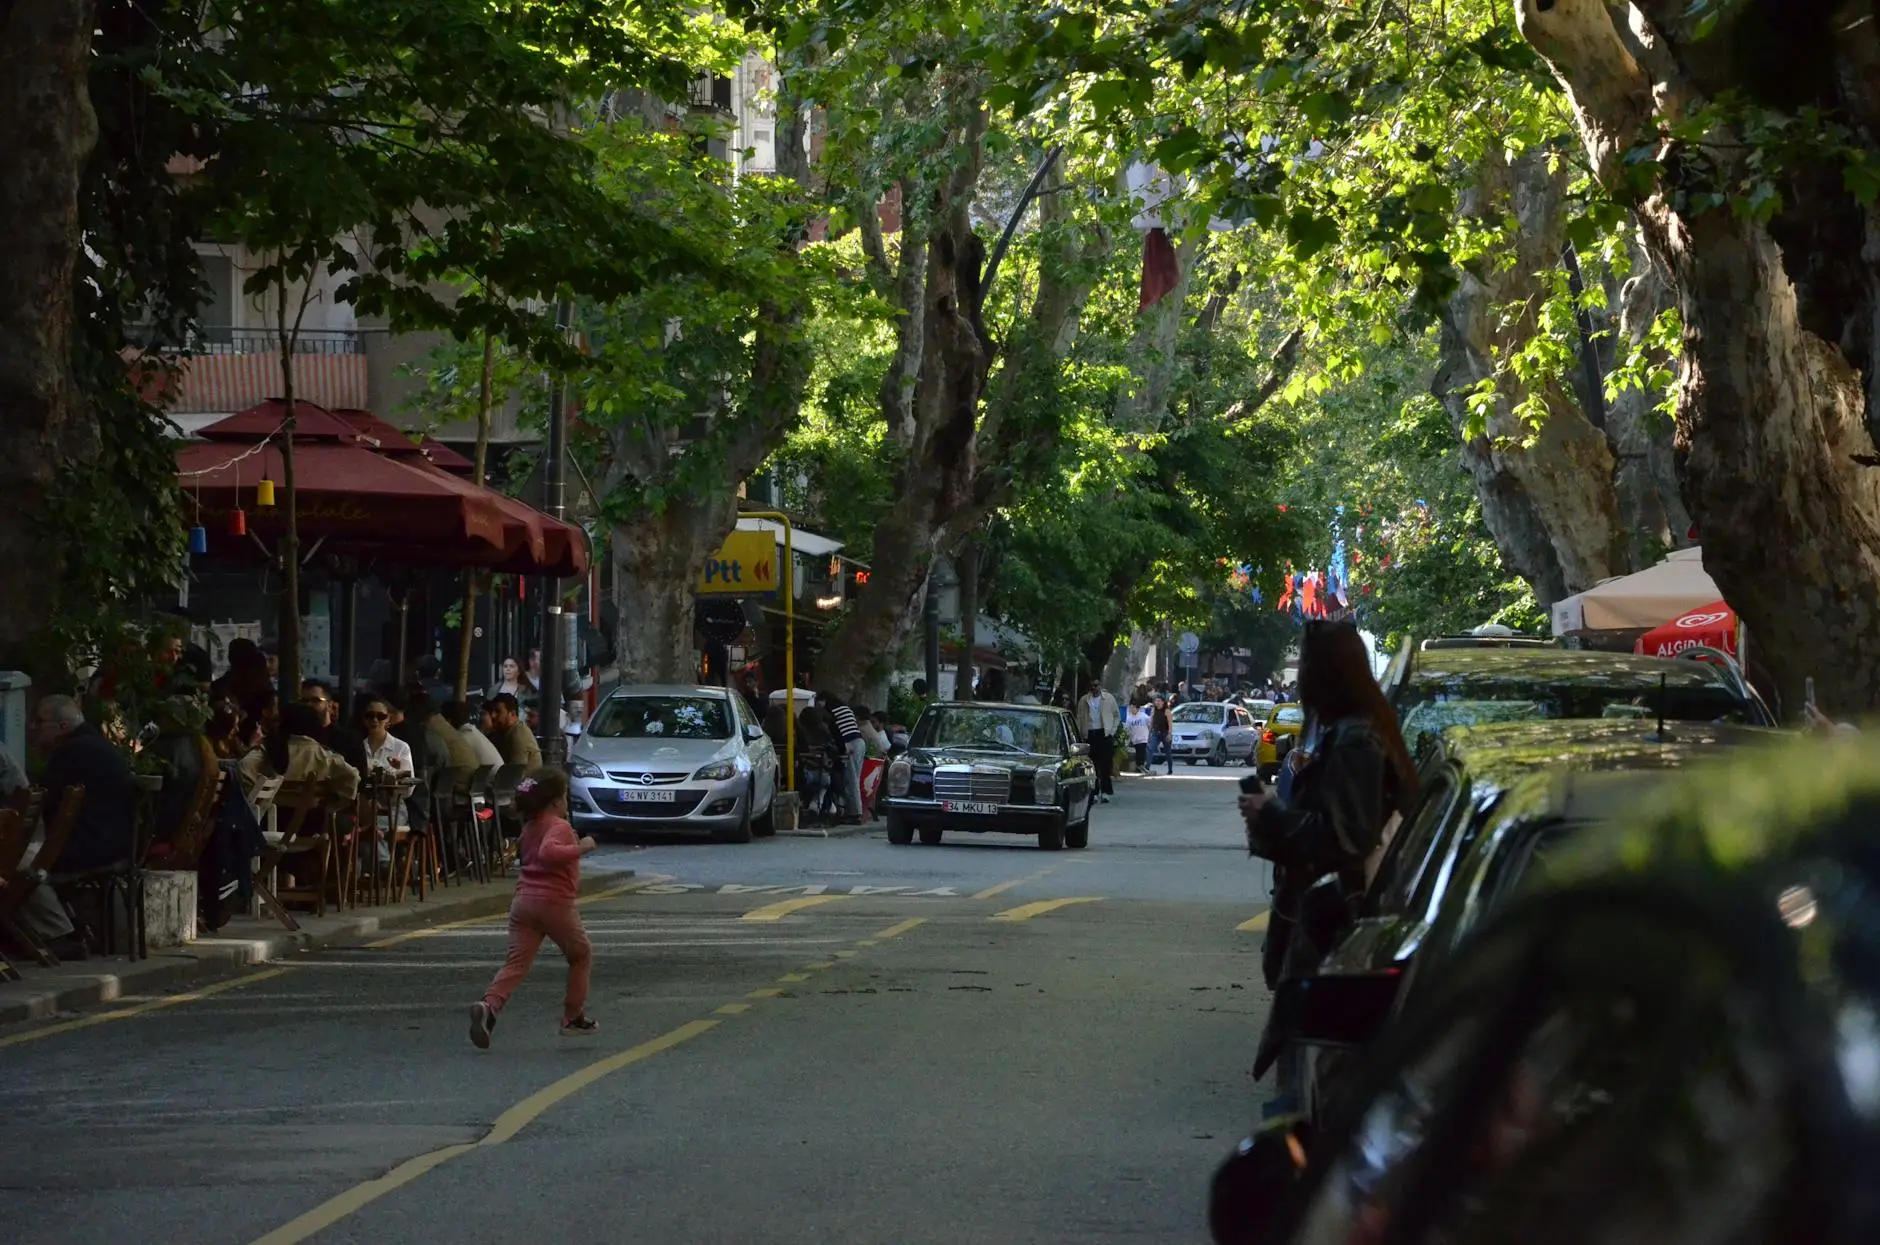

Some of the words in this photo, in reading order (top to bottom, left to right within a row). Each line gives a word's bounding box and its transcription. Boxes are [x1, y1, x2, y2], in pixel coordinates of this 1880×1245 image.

[704, 559, 742, 584] Ptt
[624, 791, 635, 801] 34
[637, 791, 648, 801] NV
[650, 791, 672, 801] 3141
[963, 803, 984, 813] MKU
[988, 804, 997, 813] 13
